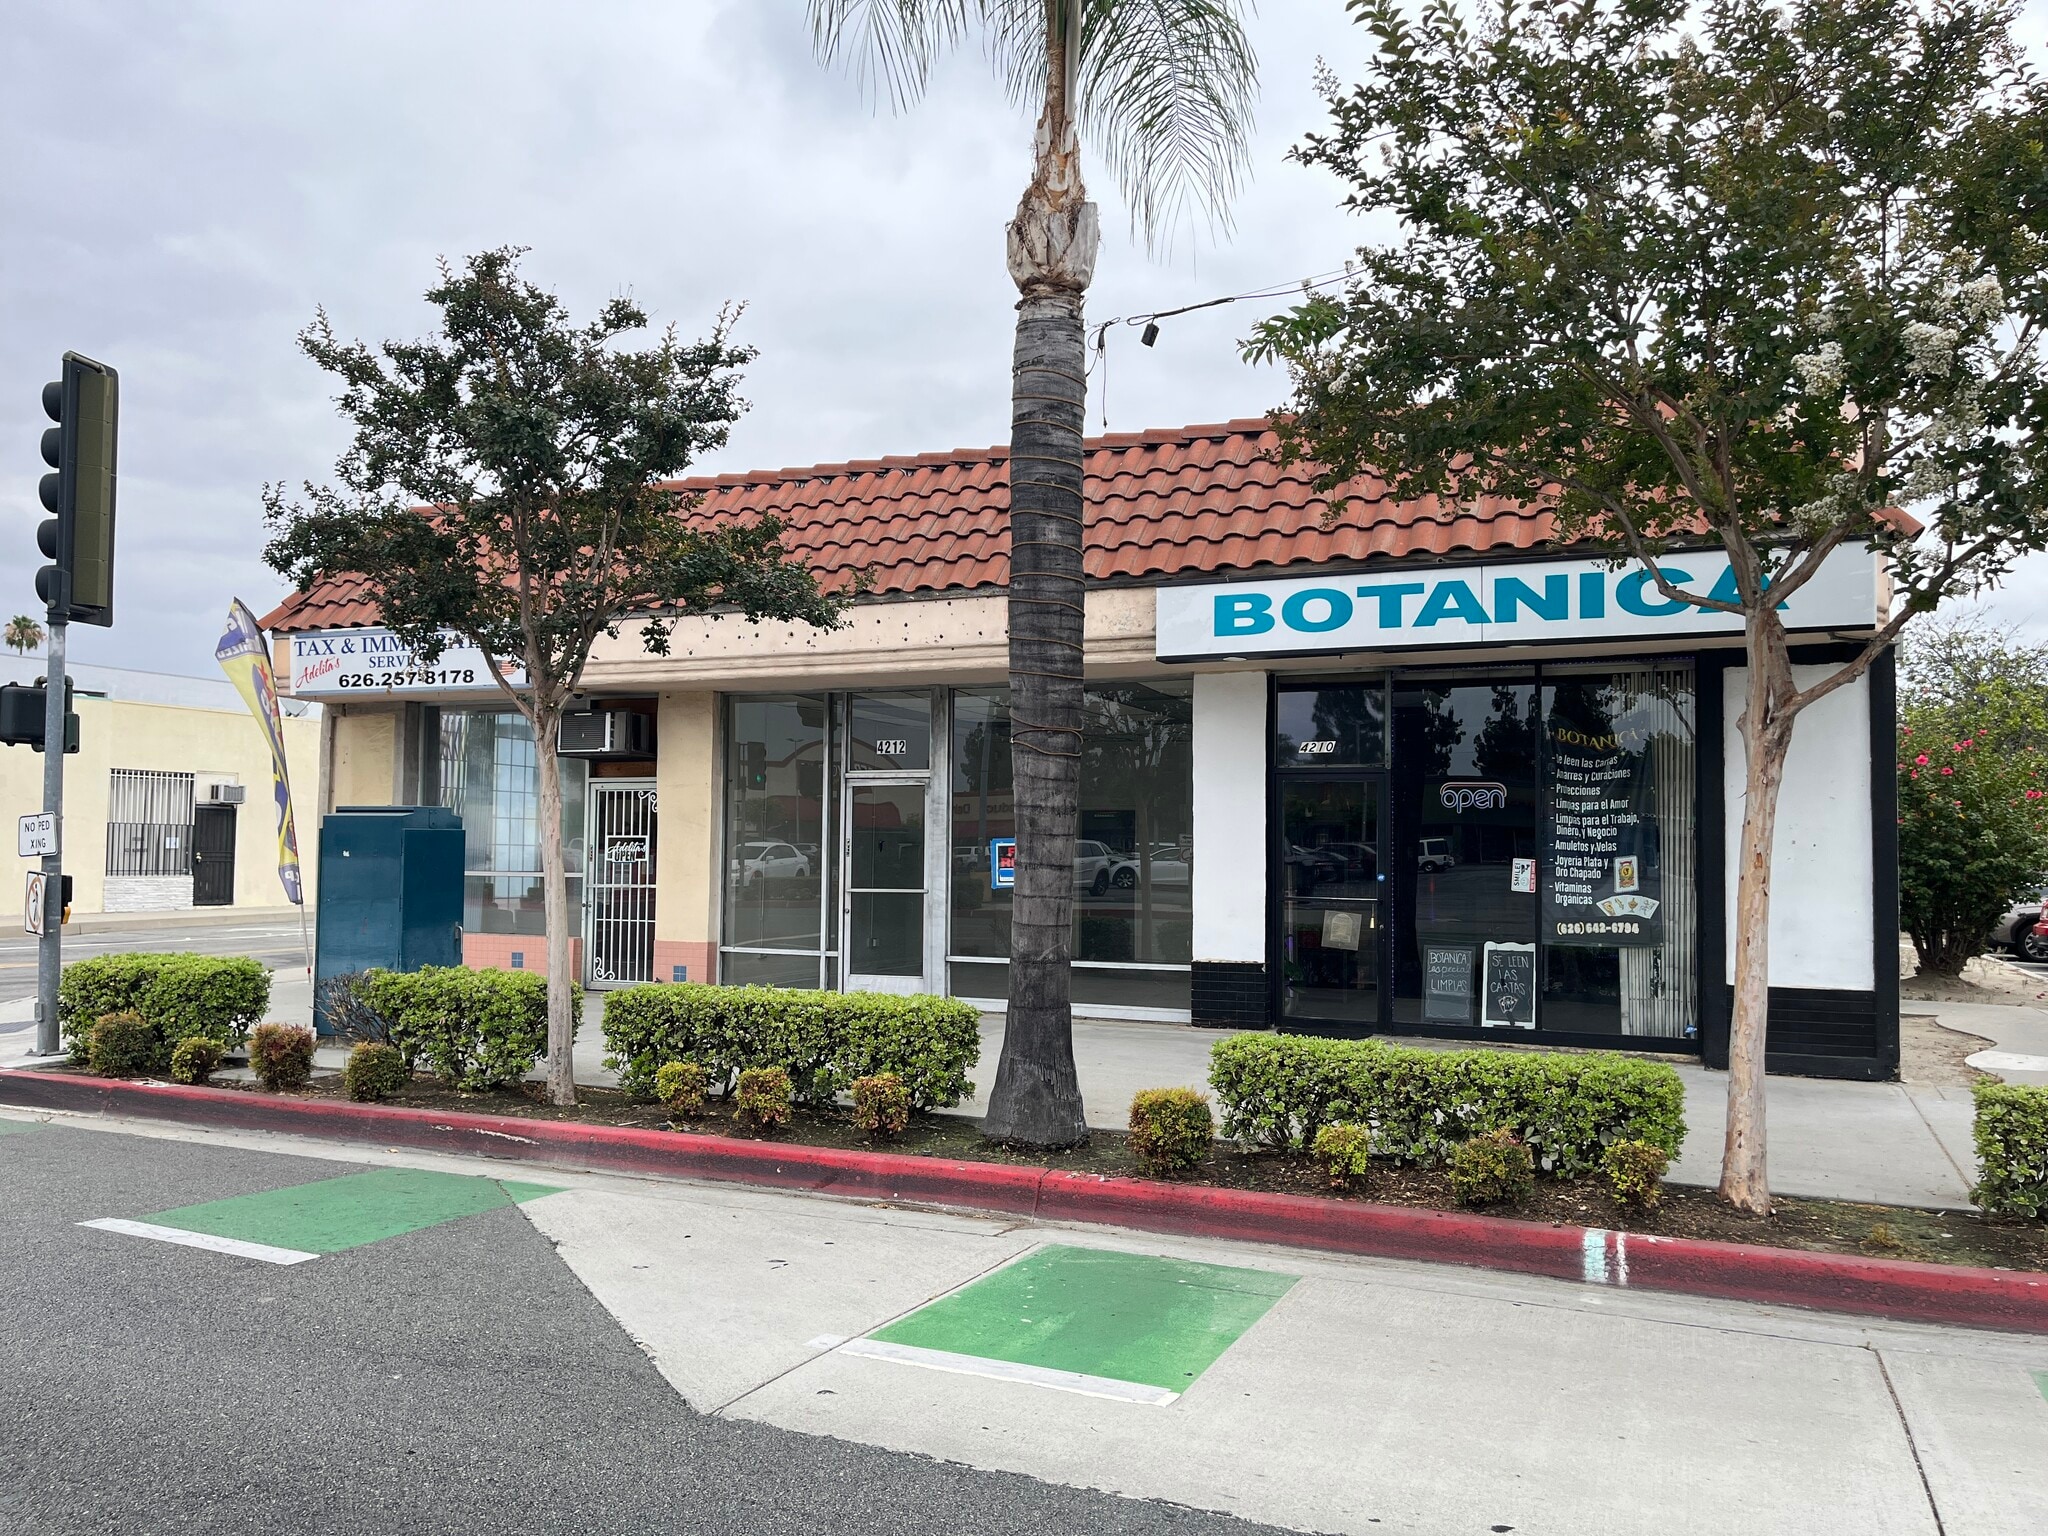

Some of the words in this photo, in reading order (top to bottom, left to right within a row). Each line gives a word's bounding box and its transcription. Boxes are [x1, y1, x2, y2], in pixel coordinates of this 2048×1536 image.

[1214, 564, 1790, 637] BOTANICA
[294, 639, 336, 656] TAX
[341, 638, 356, 654] &
[369, 654, 441, 668] SERVICS
[878, 741, 905, 753] 4212
[1300, 741, 1334, 753] 4210
[1581, 757, 1593, 768] las
[1584, 773, 1590, 784] y
[1441, 788, 1504, 814] open
[1581, 801, 1599, 813] para
[1600, 799, 1608, 810] el
[1610, 799, 1629, 809] Amor
[24, 822, 35, 833] NO
[38, 820, 50, 832] PED
[1582, 816, 1600, 828] para
[1601, 814, 1609, 825] el
[1581, 828, 1586, 839] y
[1587, 827, 1618, 840] Negocio
[30, 837, 46, 849] XING
[1555, 840, 1589, 852] Amuletos
[1595, 841, 1617, 852] Velas
[1583, 856, 1603, 867] Plata
[1603, 858, 1609, 869] y
[1555, 866, 1568, 877] Oro
[1569, 867, 1602, 881] Chapado
[1554, 881, 1592, 893] Vitaminas
[1430, 952, 1467, 964] BOTANICA
[1492, 955, 1504, 967] SE
[1507, 955, 1529, 968] LEEN
[1431, 978, 1467, 992] LIMPIAS
[1490, 981, 1526, 995] CARTAS
